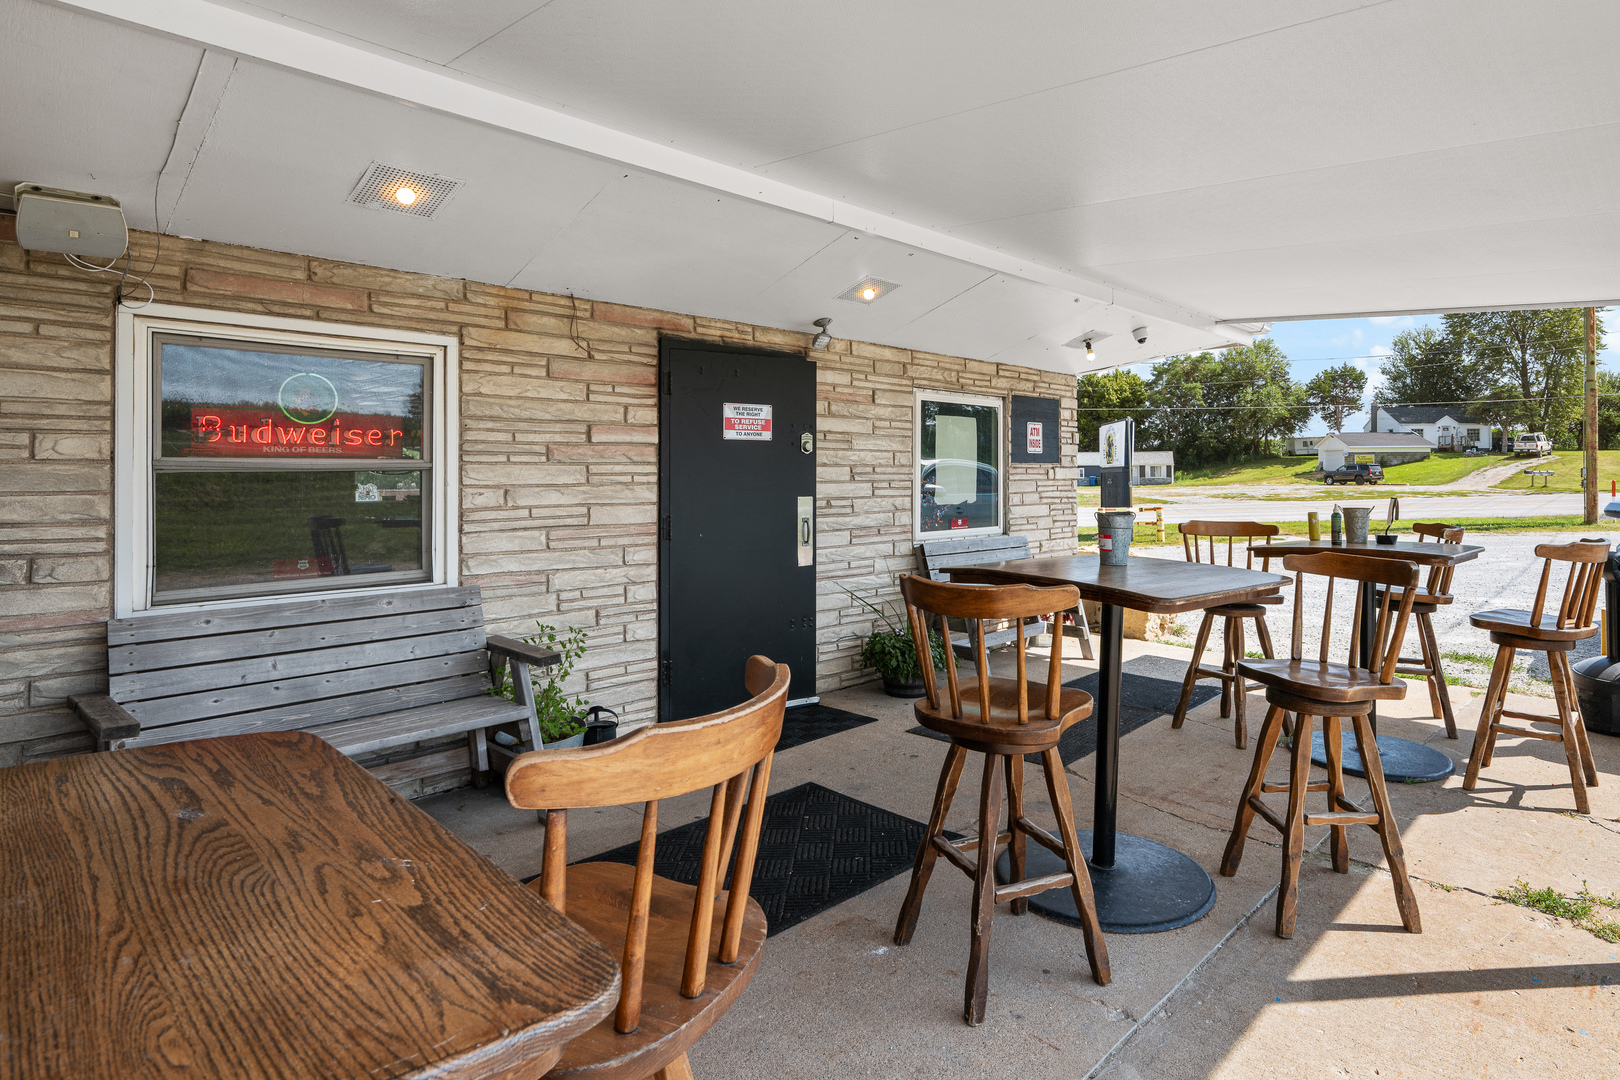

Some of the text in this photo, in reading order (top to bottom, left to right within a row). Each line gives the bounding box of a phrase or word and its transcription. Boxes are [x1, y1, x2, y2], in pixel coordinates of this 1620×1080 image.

[196, 415, 403, 446] Budweiser
[1030, 427, 1040, 436] ATM
[262, 445, 290, 453] KING
[308, 446, 343, 454] BEERS
